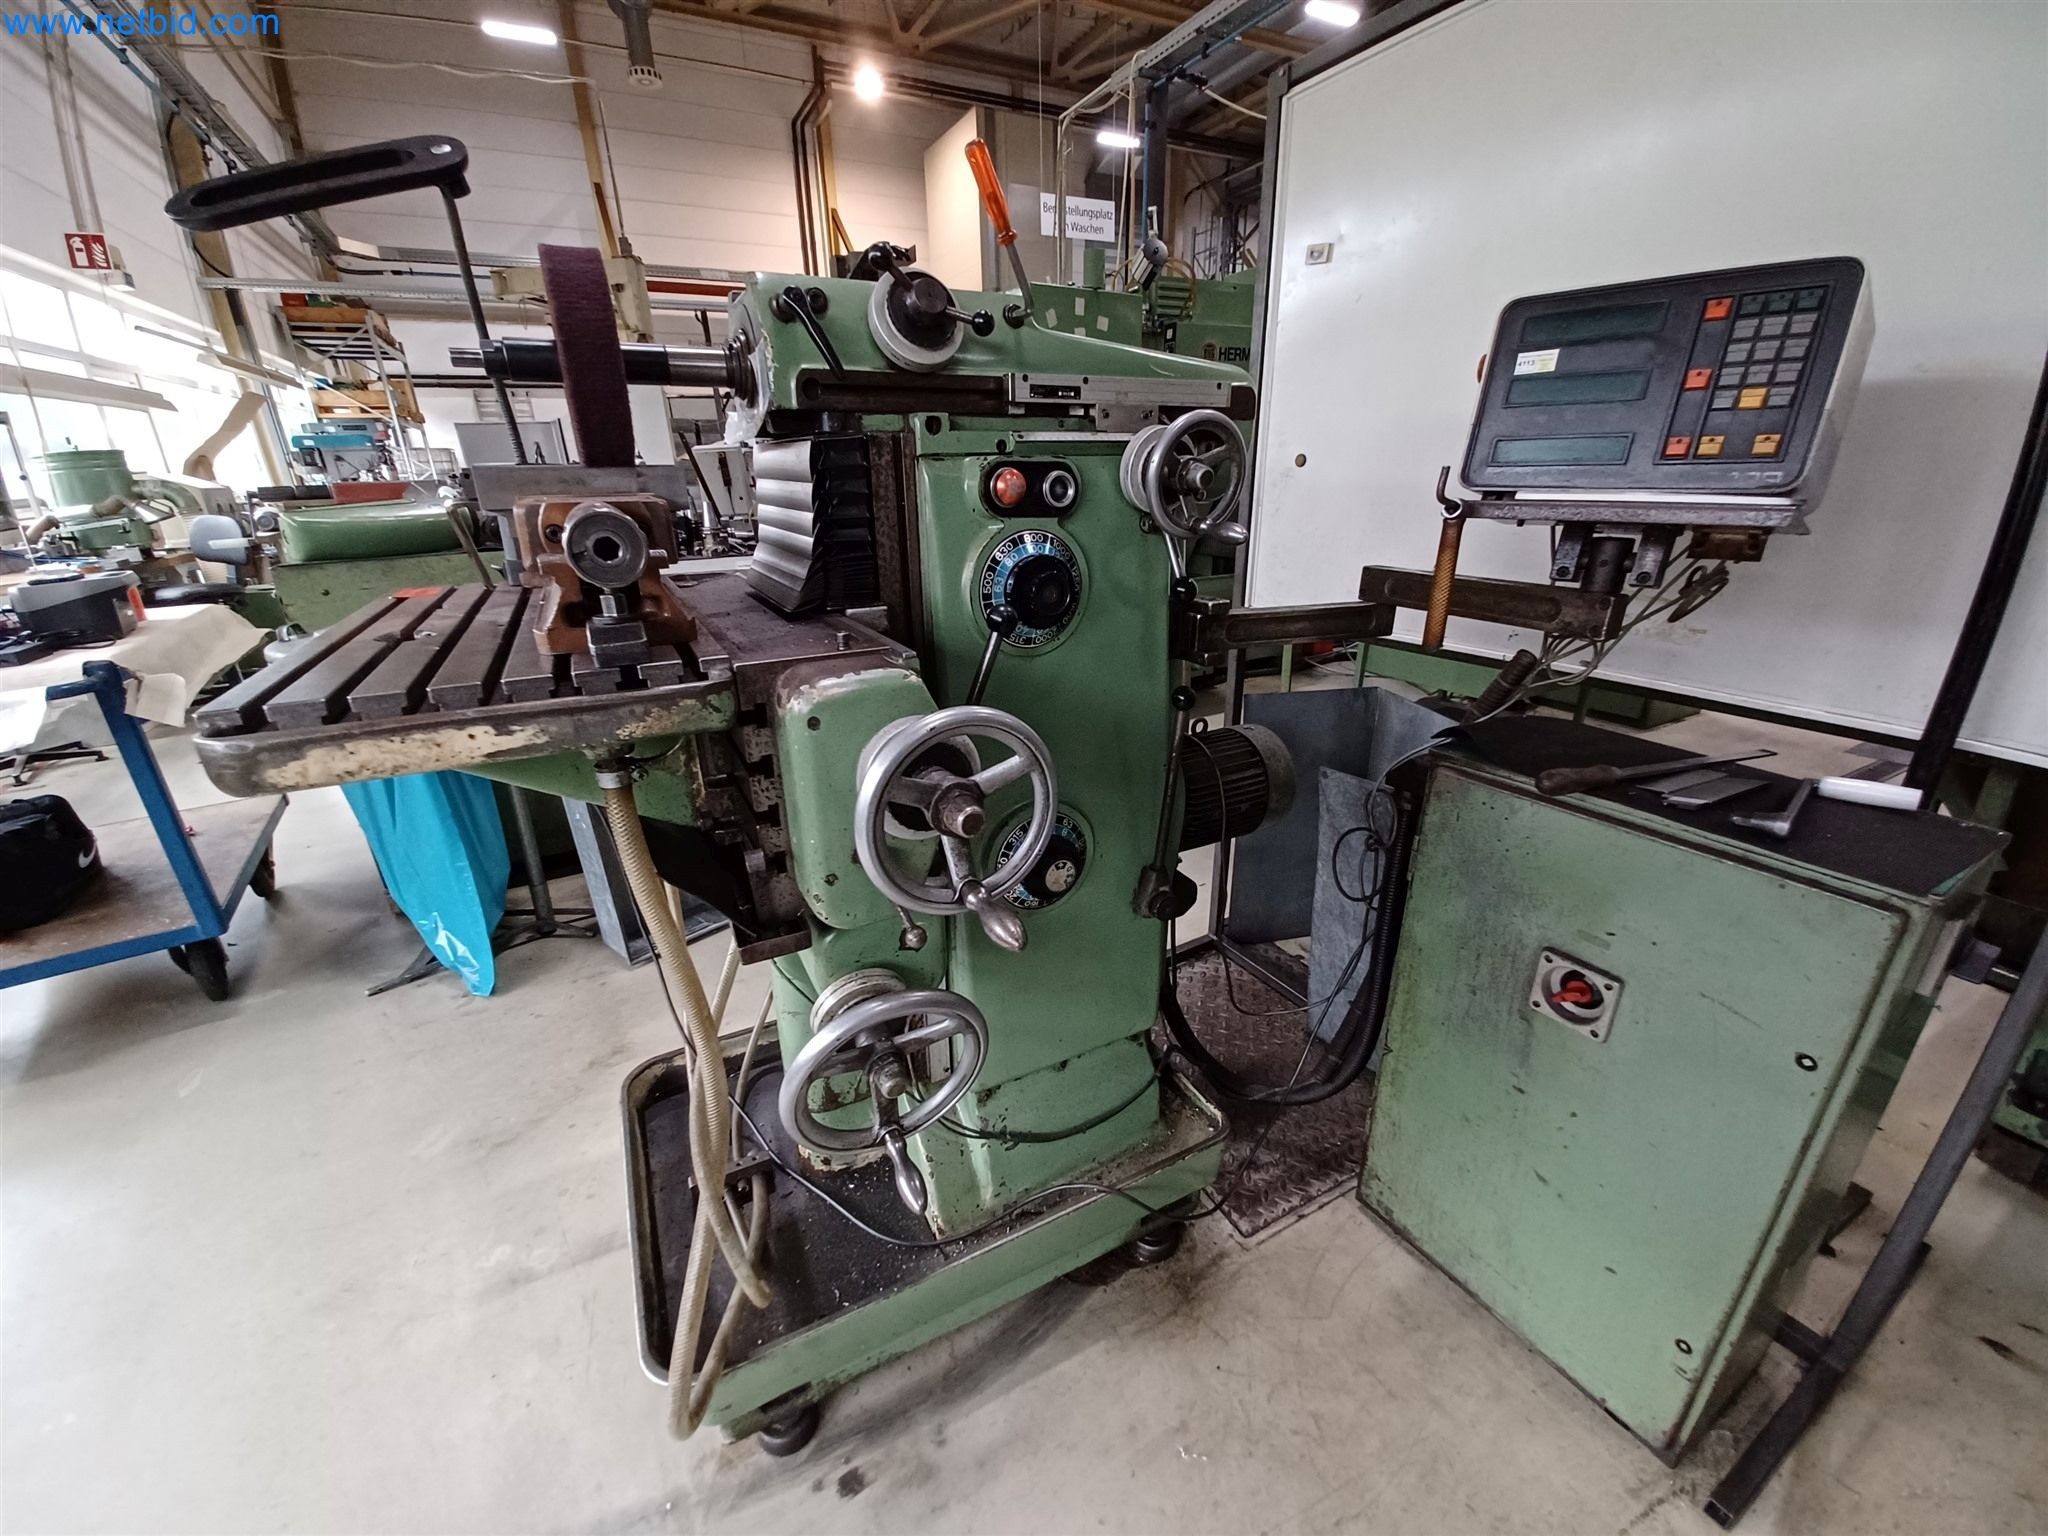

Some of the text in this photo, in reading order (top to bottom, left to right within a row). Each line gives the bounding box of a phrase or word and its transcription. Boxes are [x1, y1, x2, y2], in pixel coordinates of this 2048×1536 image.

[1043, 202, 1113, 220] Berstellungsplatz
[1071, 221, 1104, 235] Waschen
[1024, 534, 1044, 543] 800
[994, 542, 1014, 561] 630
[1053, 539, 1071, 560] 1000
[983, 571, 994, 594] 500
[994, 577, 1003, 593] 63
[1009, 633, 1027, 644] 315
[1009, 829, 1024, 846] 315
